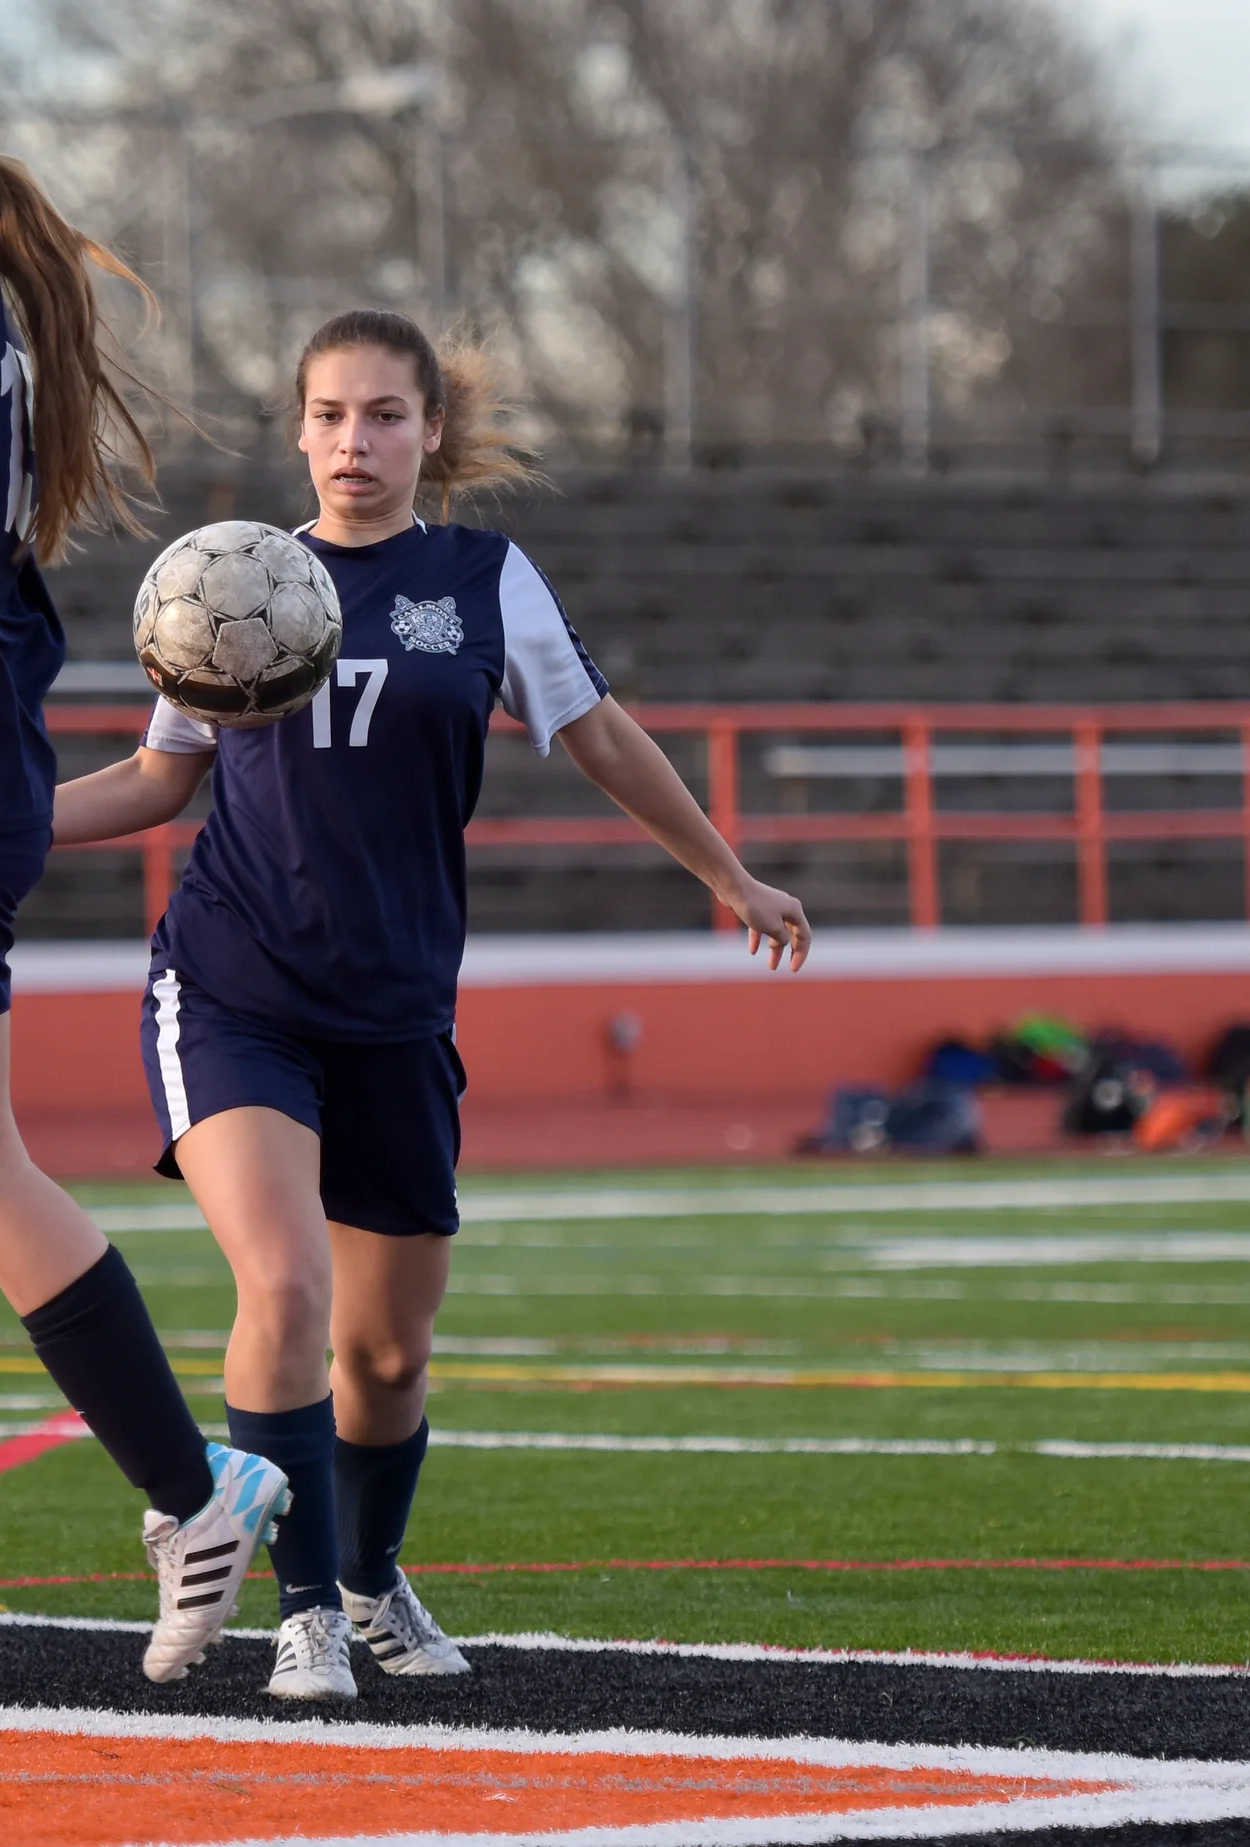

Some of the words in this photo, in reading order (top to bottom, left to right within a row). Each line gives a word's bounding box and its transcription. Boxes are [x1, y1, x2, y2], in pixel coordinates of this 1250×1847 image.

[397, 604, 457, 625] CARLMONT
[408, 636, 453, 651] SOCCER
[312, 658, 389, 749] 17
